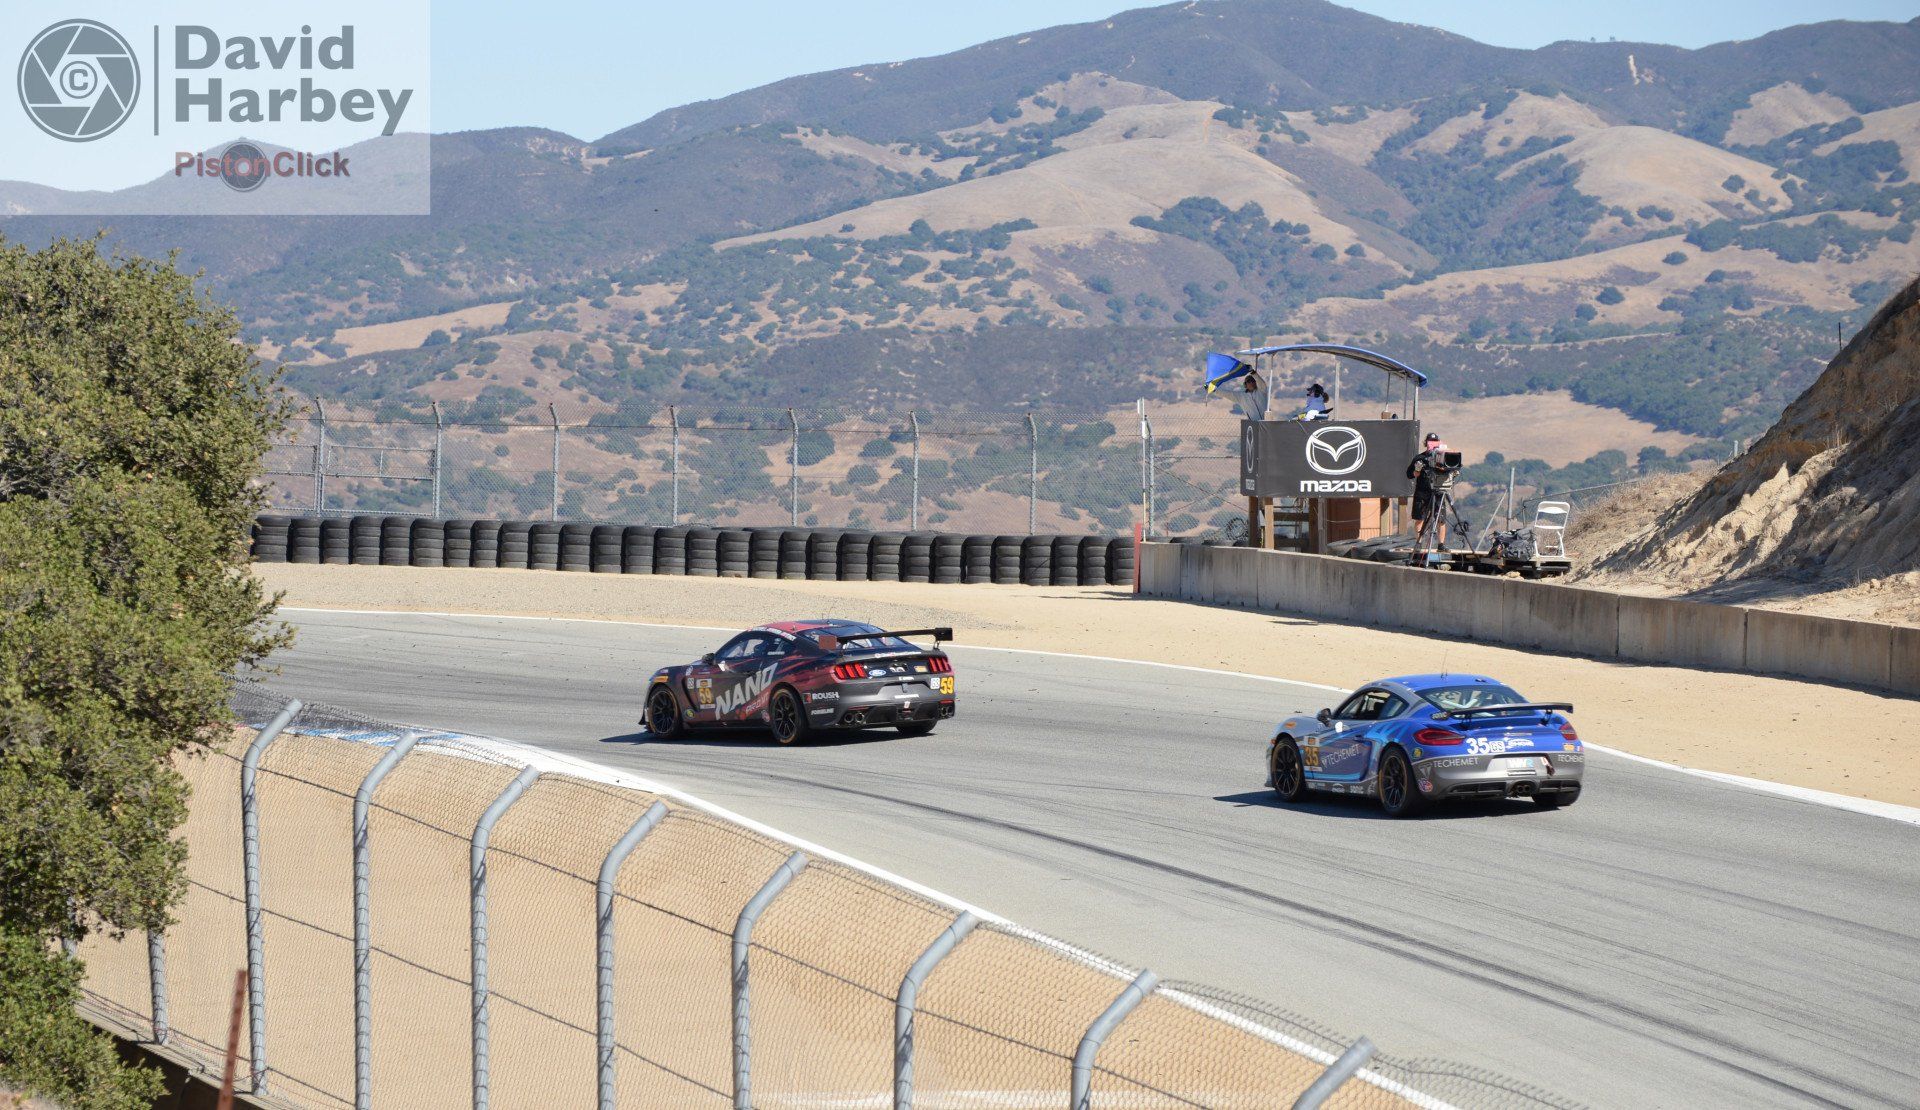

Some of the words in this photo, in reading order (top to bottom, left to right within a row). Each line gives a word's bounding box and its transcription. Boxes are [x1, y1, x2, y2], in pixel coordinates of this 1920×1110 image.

[715, 663, 778, 720] NANO
[940, 677, 954, 694] 59
[699, 688, 712, 704] 59
[812, 692, 839, 700] ROUSH
[1327, 744, 1361, 765] TECHEMET
[1466, 737, 1490, 755] 35
[1304, 747, 1318, 766] 35
[1433, 757, 1479, 768] TECHEMET
